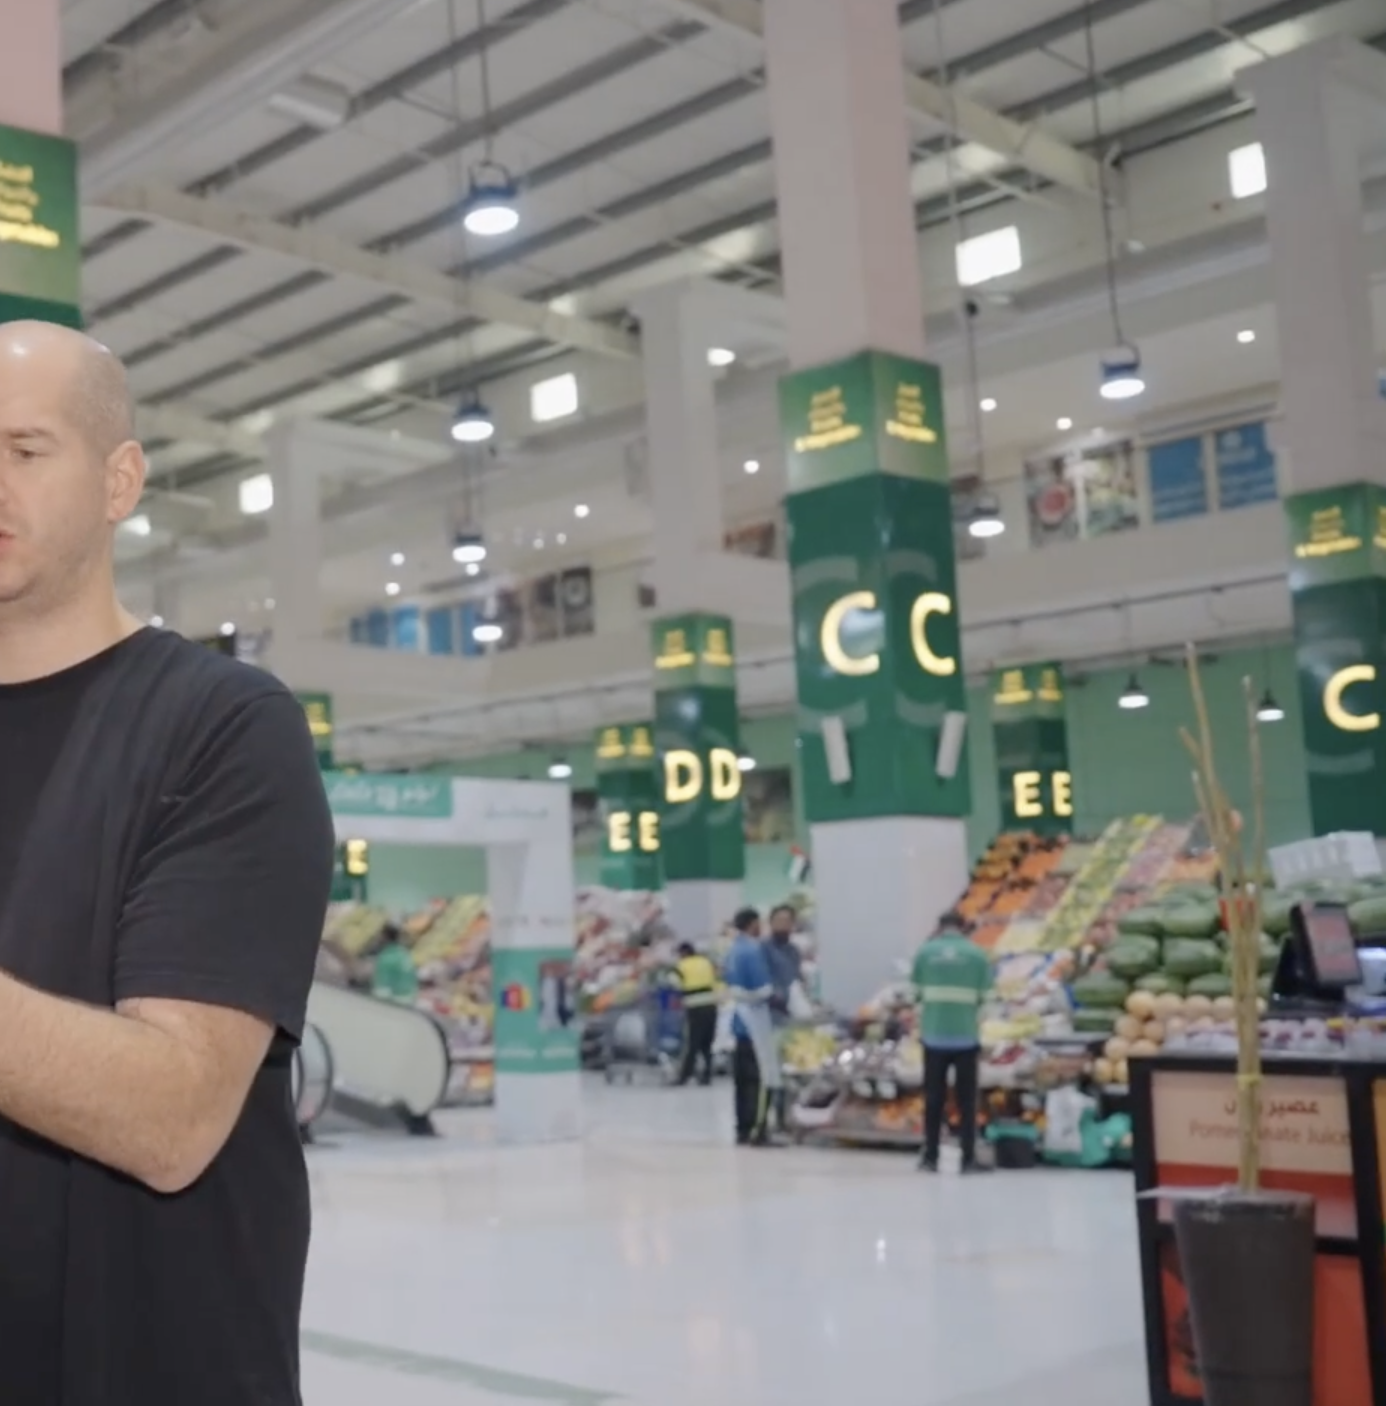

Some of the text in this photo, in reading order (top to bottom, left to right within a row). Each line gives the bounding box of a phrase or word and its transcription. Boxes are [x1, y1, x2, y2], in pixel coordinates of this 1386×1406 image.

[821, 590, 880, 676] C
[911, 591, 955, 676] C
[1322, 664, 1381, 732] C
[665, 749, 703, 803] D
[710, 748, 741, 800] D
[1013, 771, 1043, 818] E
[1052, 770, 1073, 816] E
[609, 811, 632, 851] E
[638, 811, 660, 851] E
